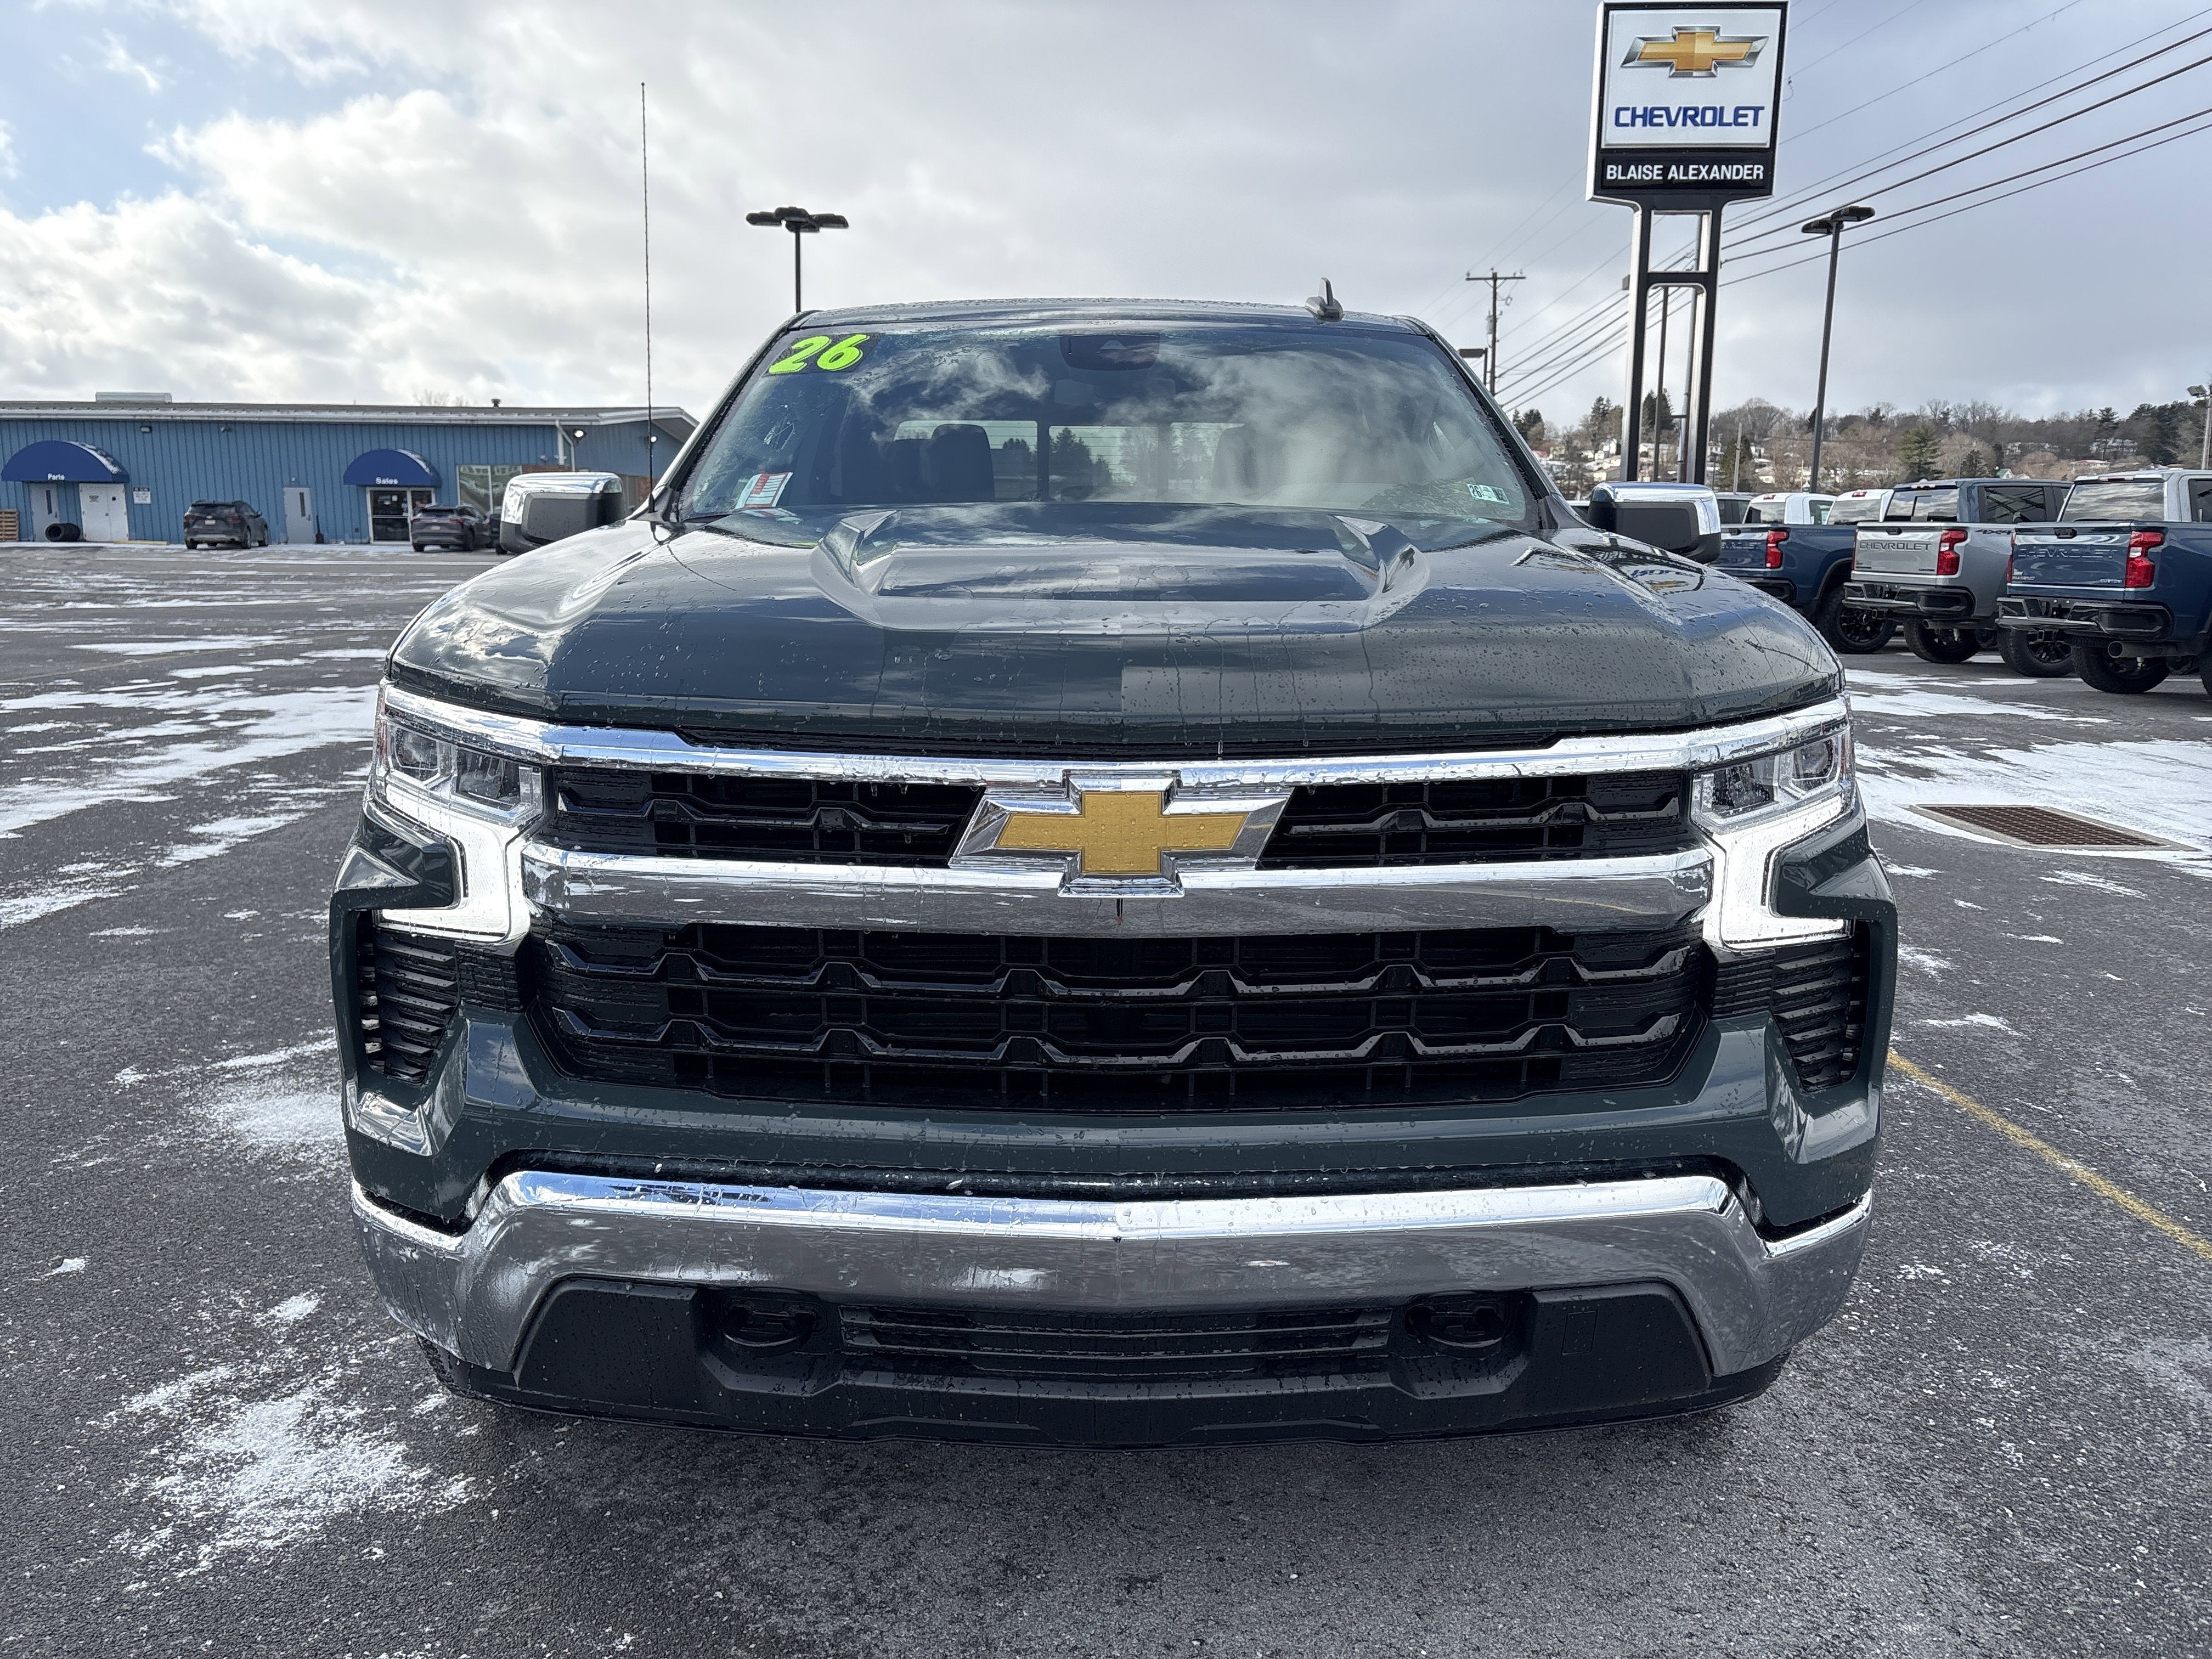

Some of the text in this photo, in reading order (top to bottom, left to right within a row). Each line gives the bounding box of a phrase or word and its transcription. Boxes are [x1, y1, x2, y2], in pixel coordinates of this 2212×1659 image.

[1614, 106, 1765, 127] CHEVROLET
[1606, 165, 1764, 180] BLAISE ALEXANDER
[769, 334, 870, 374] 26
[375, 477, 399, 485] Sales
[1469, 484, 1483, 498] 26
[1859, 541, 1932, 552] CHEVROLET
[2018, 548, 2118, 558] CHEVROLET
